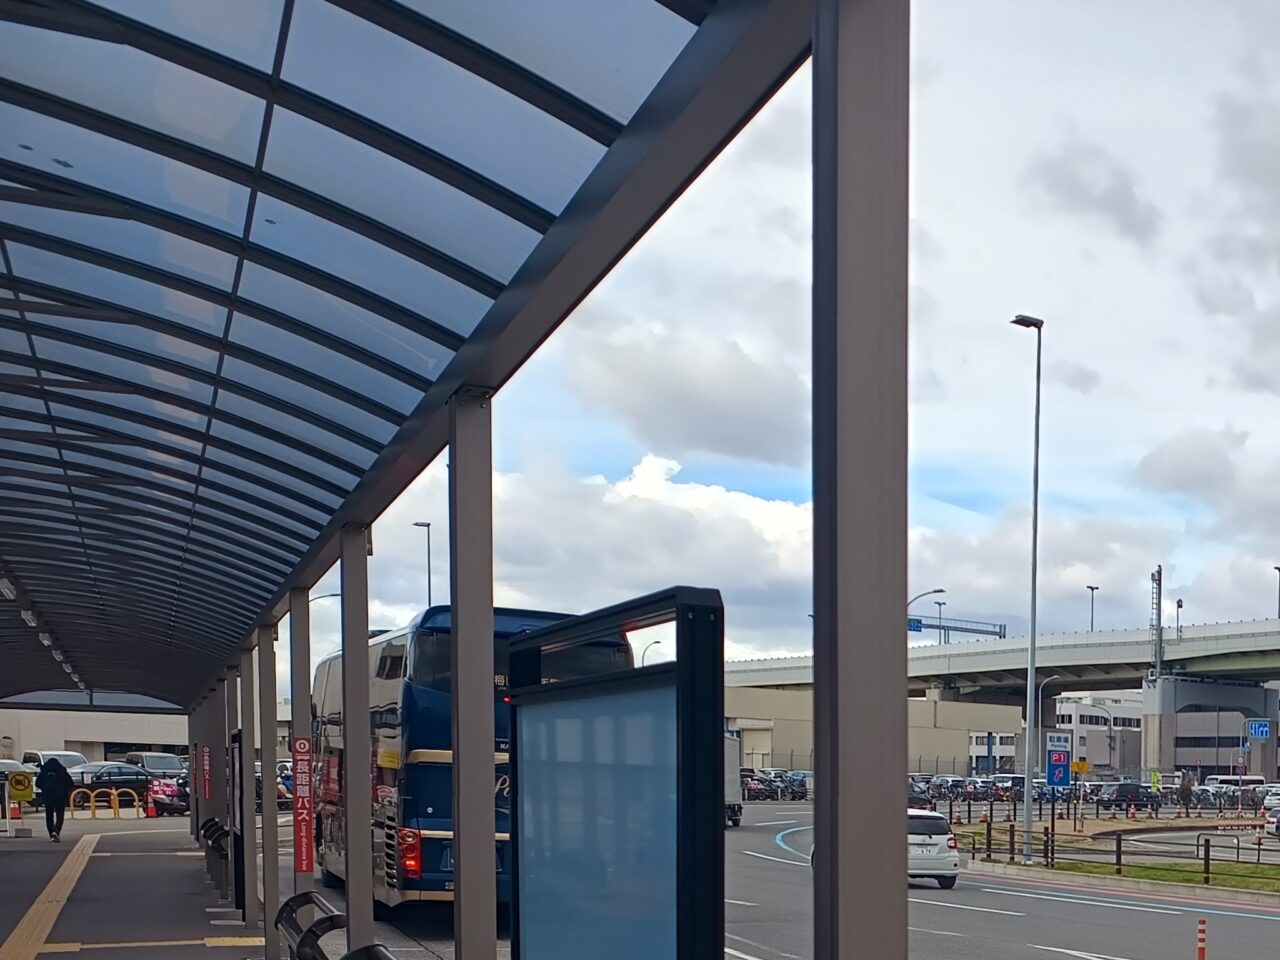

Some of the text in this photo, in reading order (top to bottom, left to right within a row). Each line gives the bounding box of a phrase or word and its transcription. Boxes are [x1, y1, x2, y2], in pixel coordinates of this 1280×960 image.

[1052, 754, 1065, 762] P1
[296, 761, 310, 820] 長距離バス
